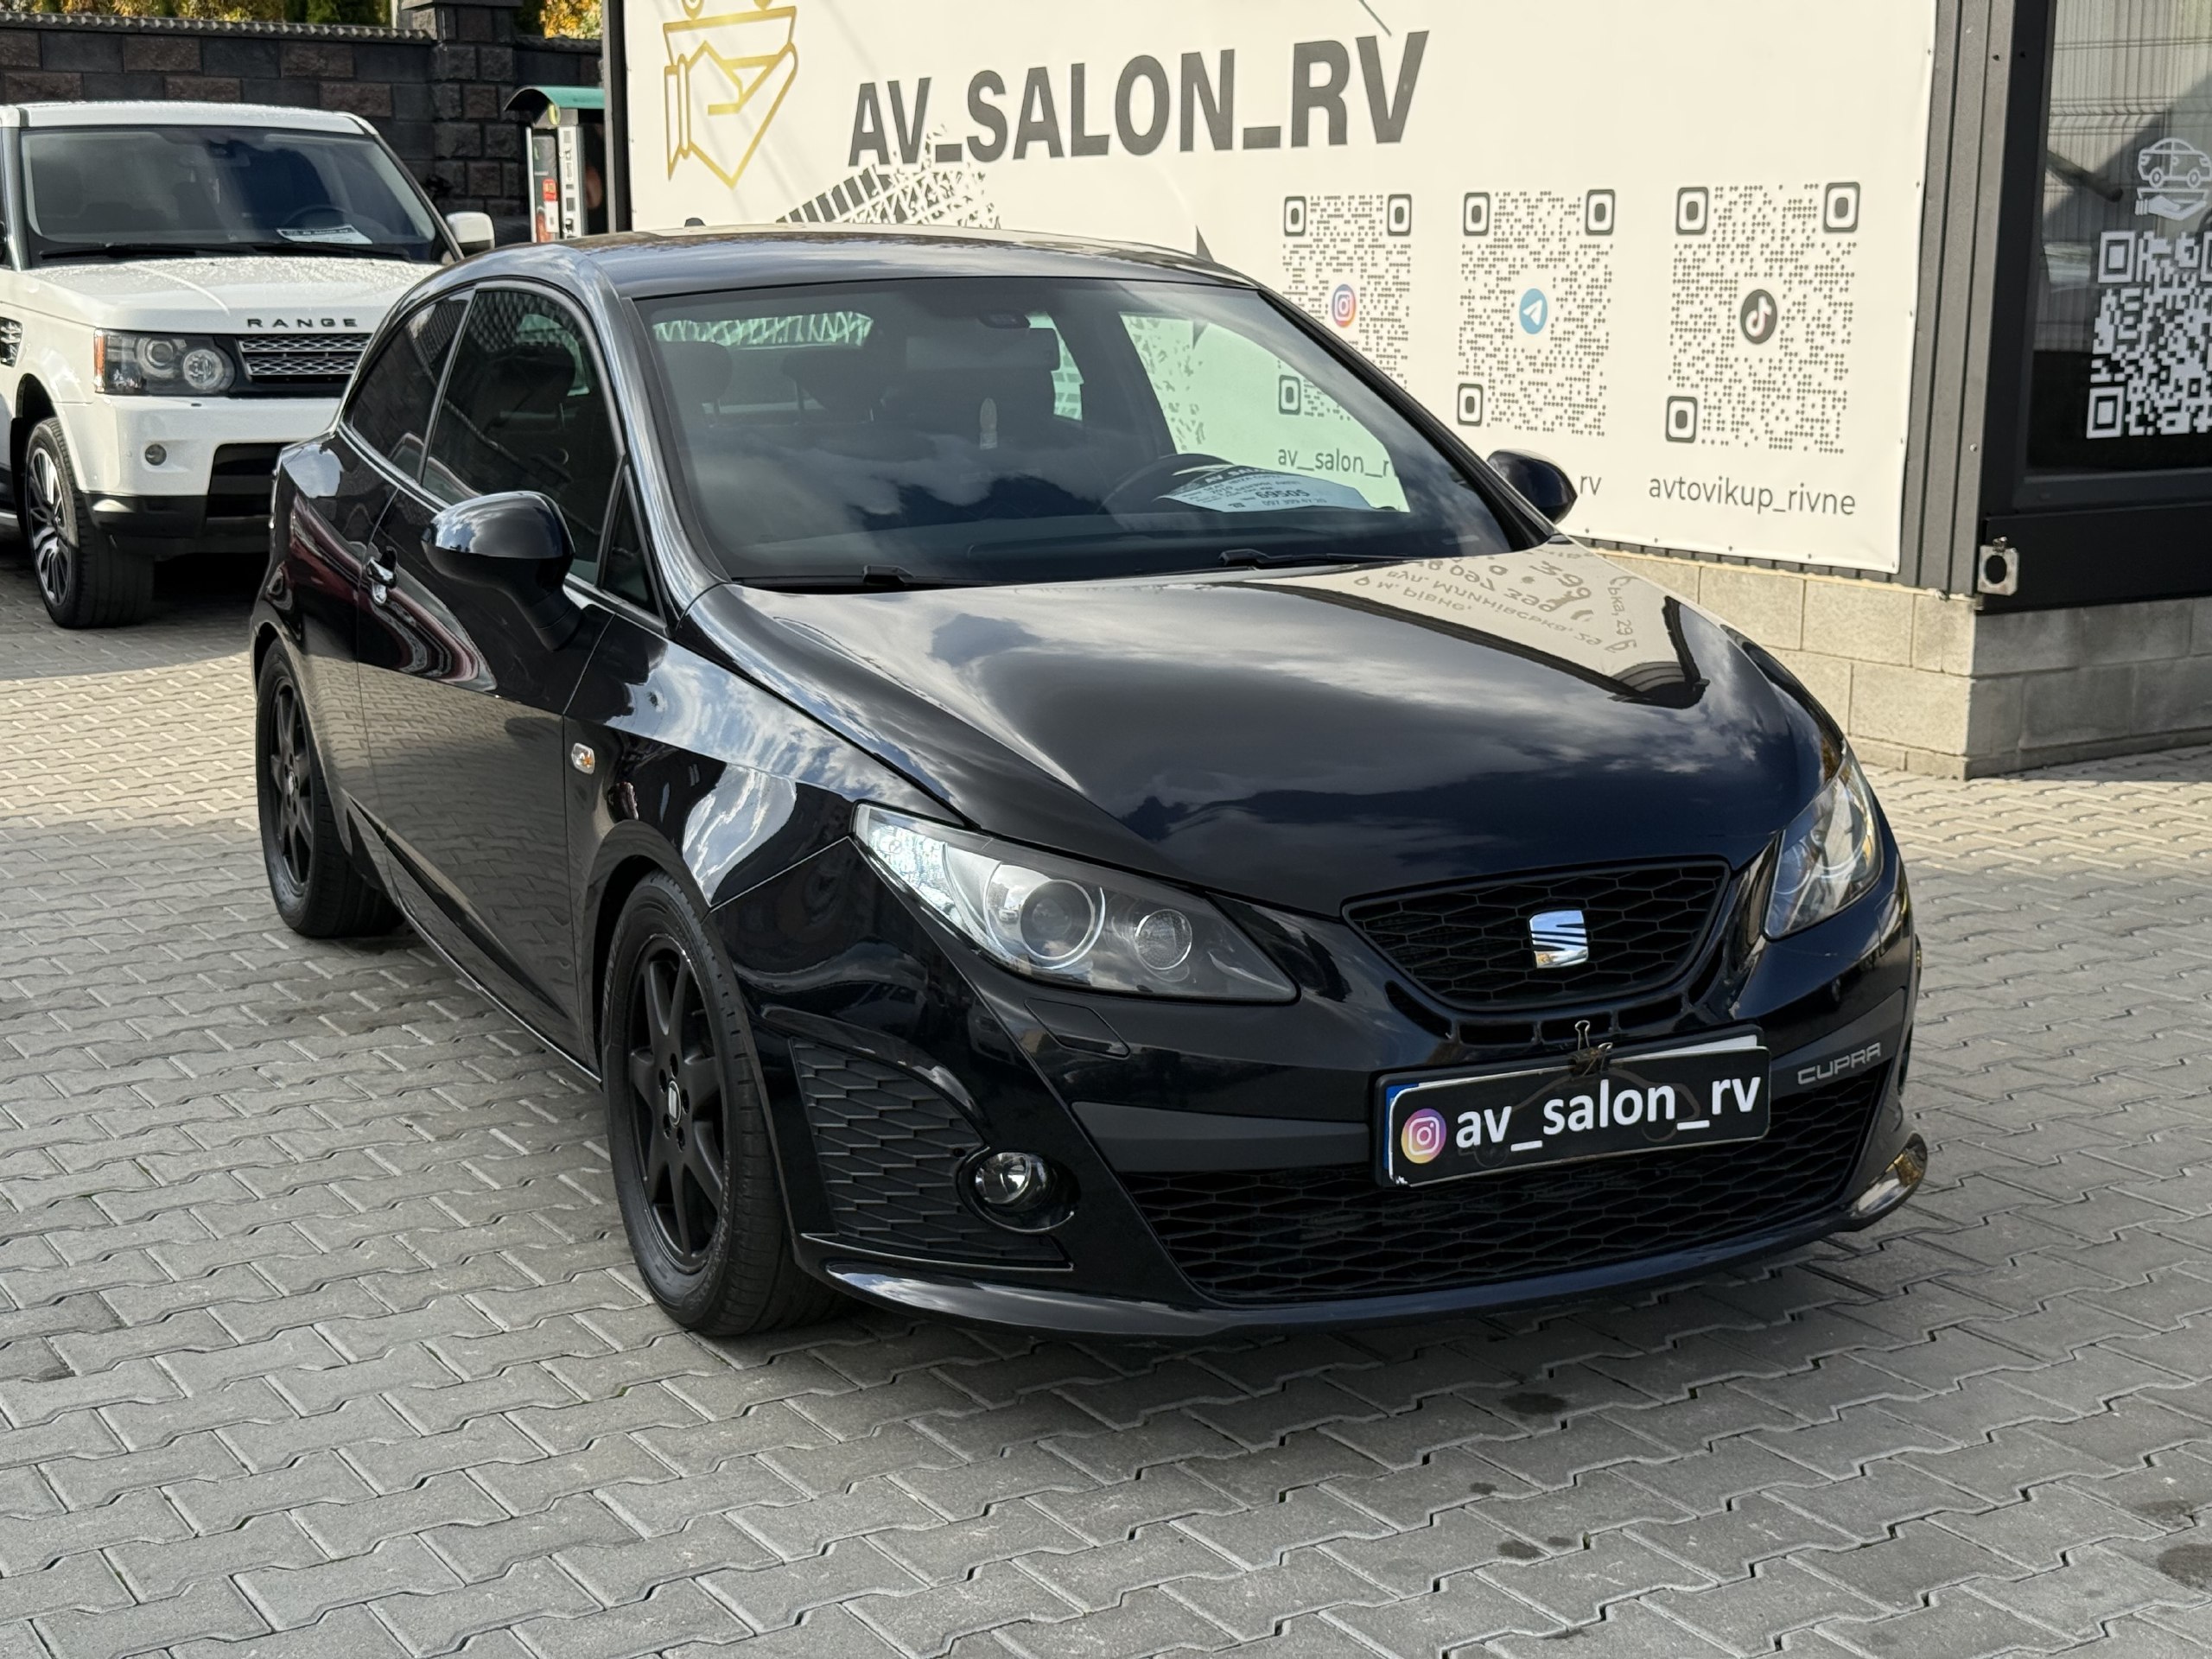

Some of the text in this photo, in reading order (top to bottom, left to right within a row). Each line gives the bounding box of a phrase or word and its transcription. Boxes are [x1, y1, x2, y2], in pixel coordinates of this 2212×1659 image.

[848, 30, 1430, 168] AV_SALON_RV
[247, 318, 357, 328] RANGE
[1278, 448, 1390, 478] av_salon_r
[1649, 475, 1856, 516] avtovikup_rivne
[1797, 1042, 1882, 1085] CUPRA
[1455, 1077, 1762, 1152] av_salon_rv
